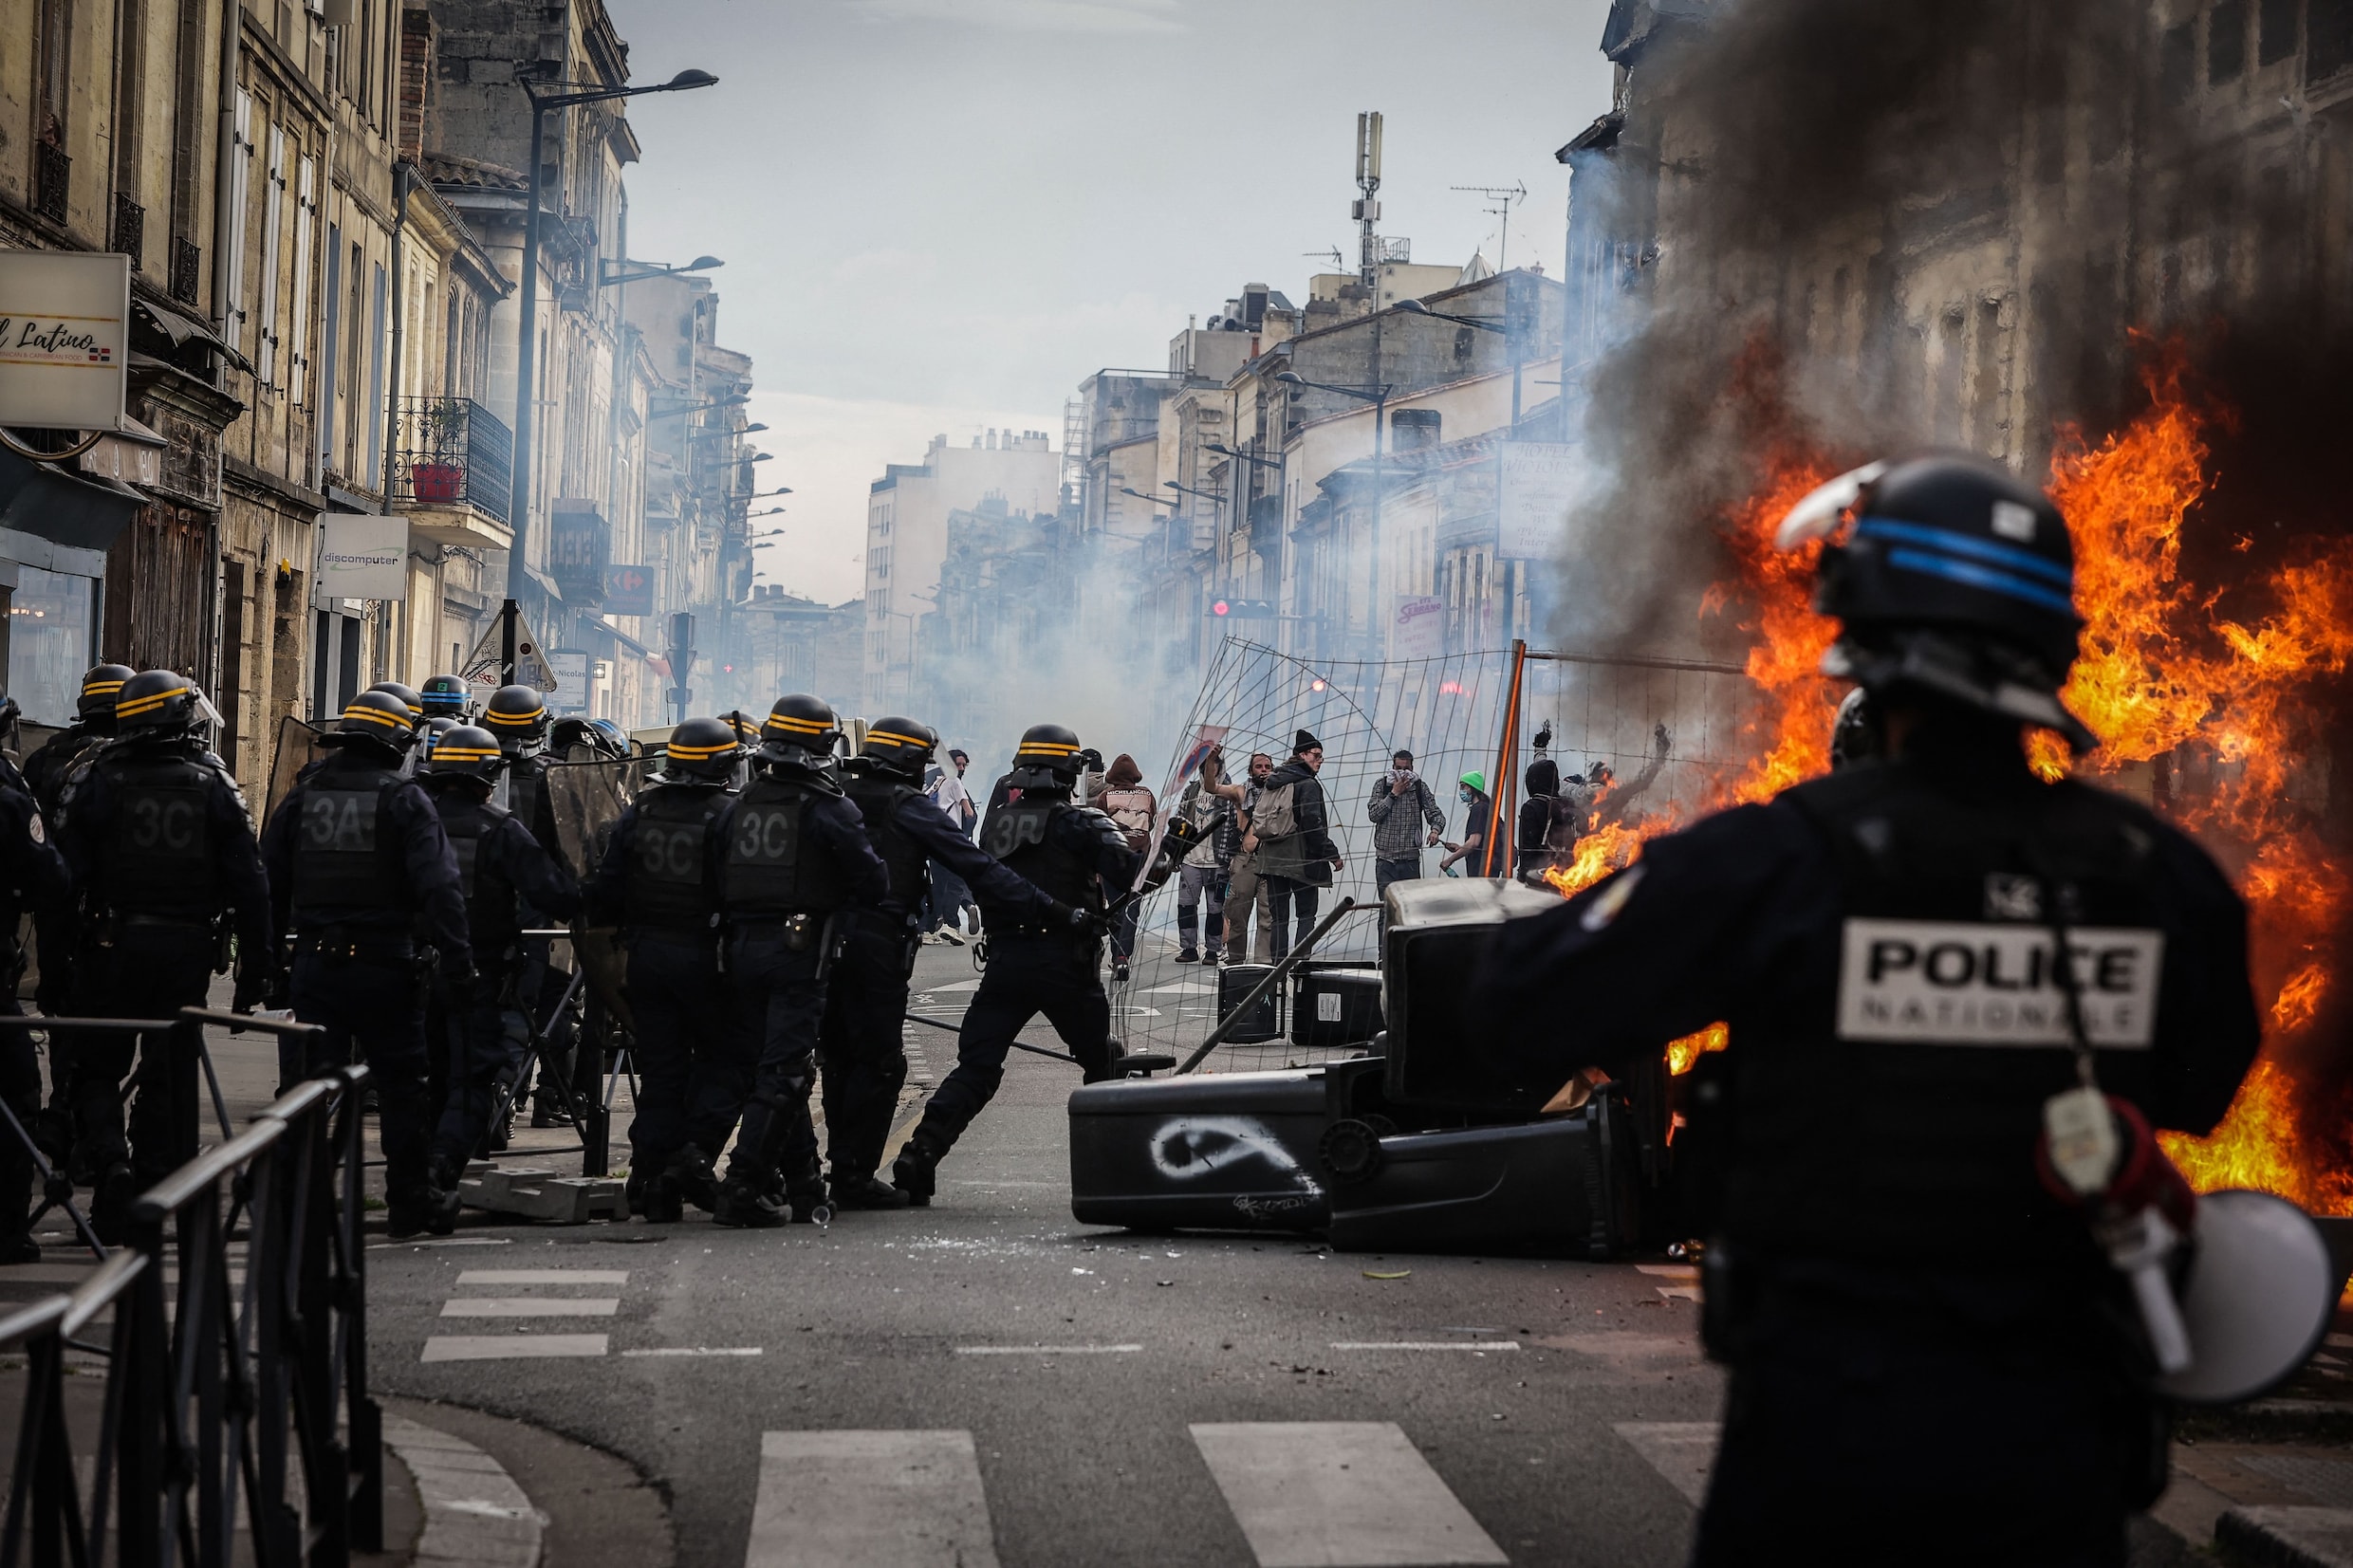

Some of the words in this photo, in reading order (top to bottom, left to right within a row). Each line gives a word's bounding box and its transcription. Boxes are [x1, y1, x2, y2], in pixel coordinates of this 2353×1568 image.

[16, 322, 96, 353] Latino
[1503, 458, 1572, 473] VICTOIR
[1517, 444, 1571, 458] HOTEL
[324, 552, 398, 566] discomputer
[1397, 601, 1442, 625] SERRANO
[132, 797, 195, 850] 3C
[310, 797, 365, 847] 3A
[739, 812, 789, 858] 3C
[643, 827, 694, 876] 3C
[1867, 937, 2140, 992] POLICE
